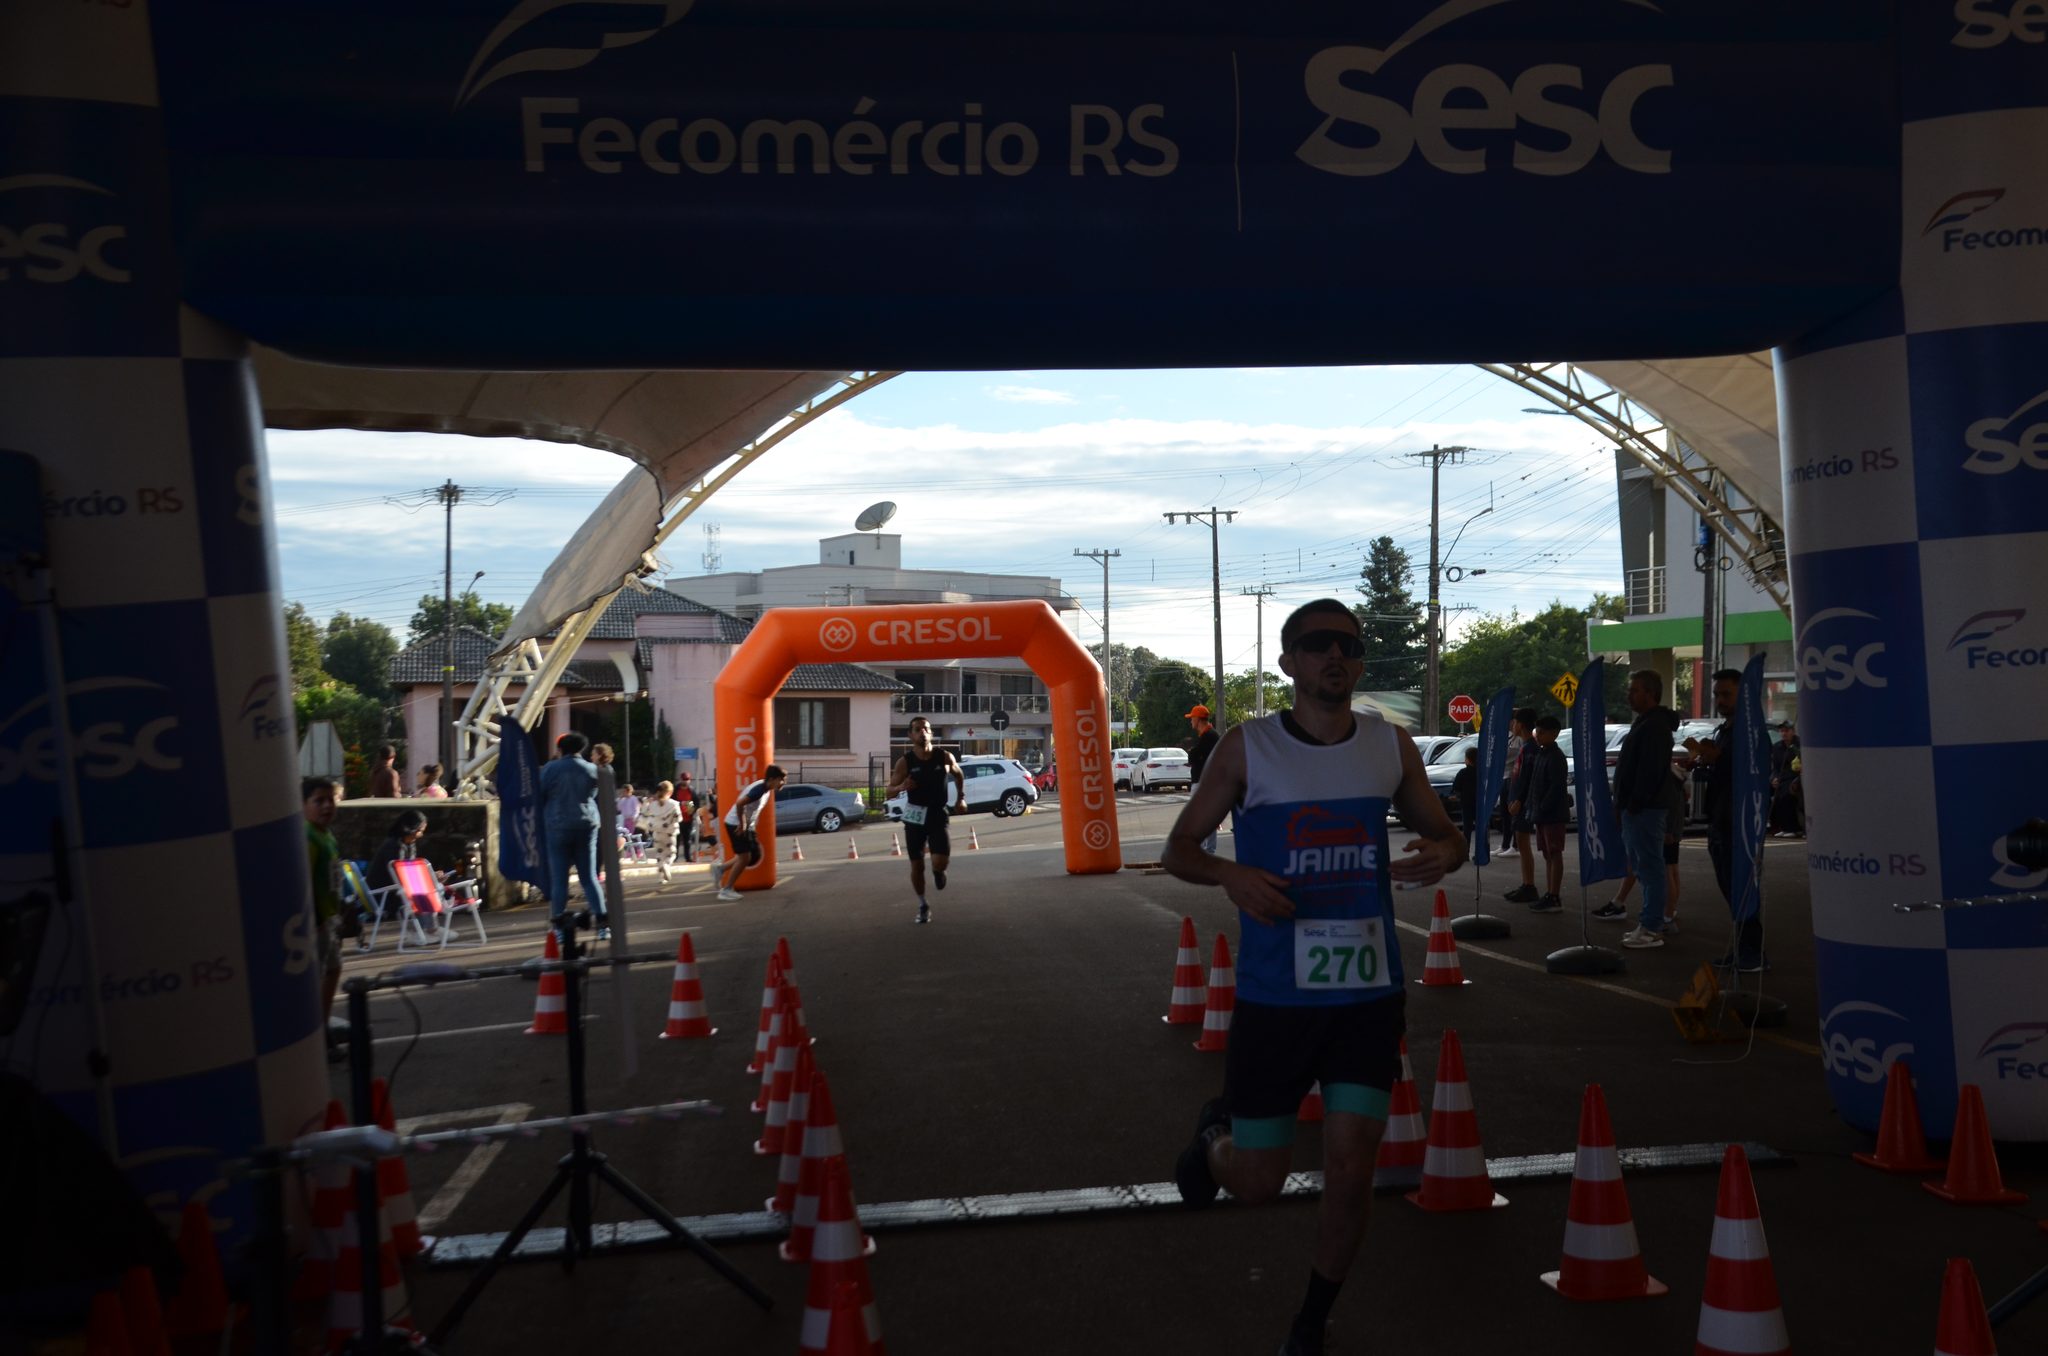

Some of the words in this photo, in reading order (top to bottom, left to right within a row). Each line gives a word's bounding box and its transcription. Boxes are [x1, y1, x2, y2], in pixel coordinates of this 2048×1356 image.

[1294, 44, 1675, 177] Sesc
[520, 97, 1040, 176] Fecomércio
[1069, 103, 1180, 177] RS
[1943, 227, 2048, 252] Fecom
[1788, 455, 1853, 484] mércio
[1862, 447, 1899, 473] RS
[43, 489, 127, 517] ércio
[136, 486, 184, 515] RS
[868, 616, 1002, 647] CRESOL
[1800, 642, 1889, 691] esc
[1451, 704, 1475, 714] PARE
[734, 716, 758, 791] ESOL
[1075, 700, 1105, 811] CRESOL
[1283, 844, 1378, 875] JAIME
[1889, 854, 1927, 876] RS
[192, 956, 234, 986] RS
[1307, 944, 1377, 983] 270
